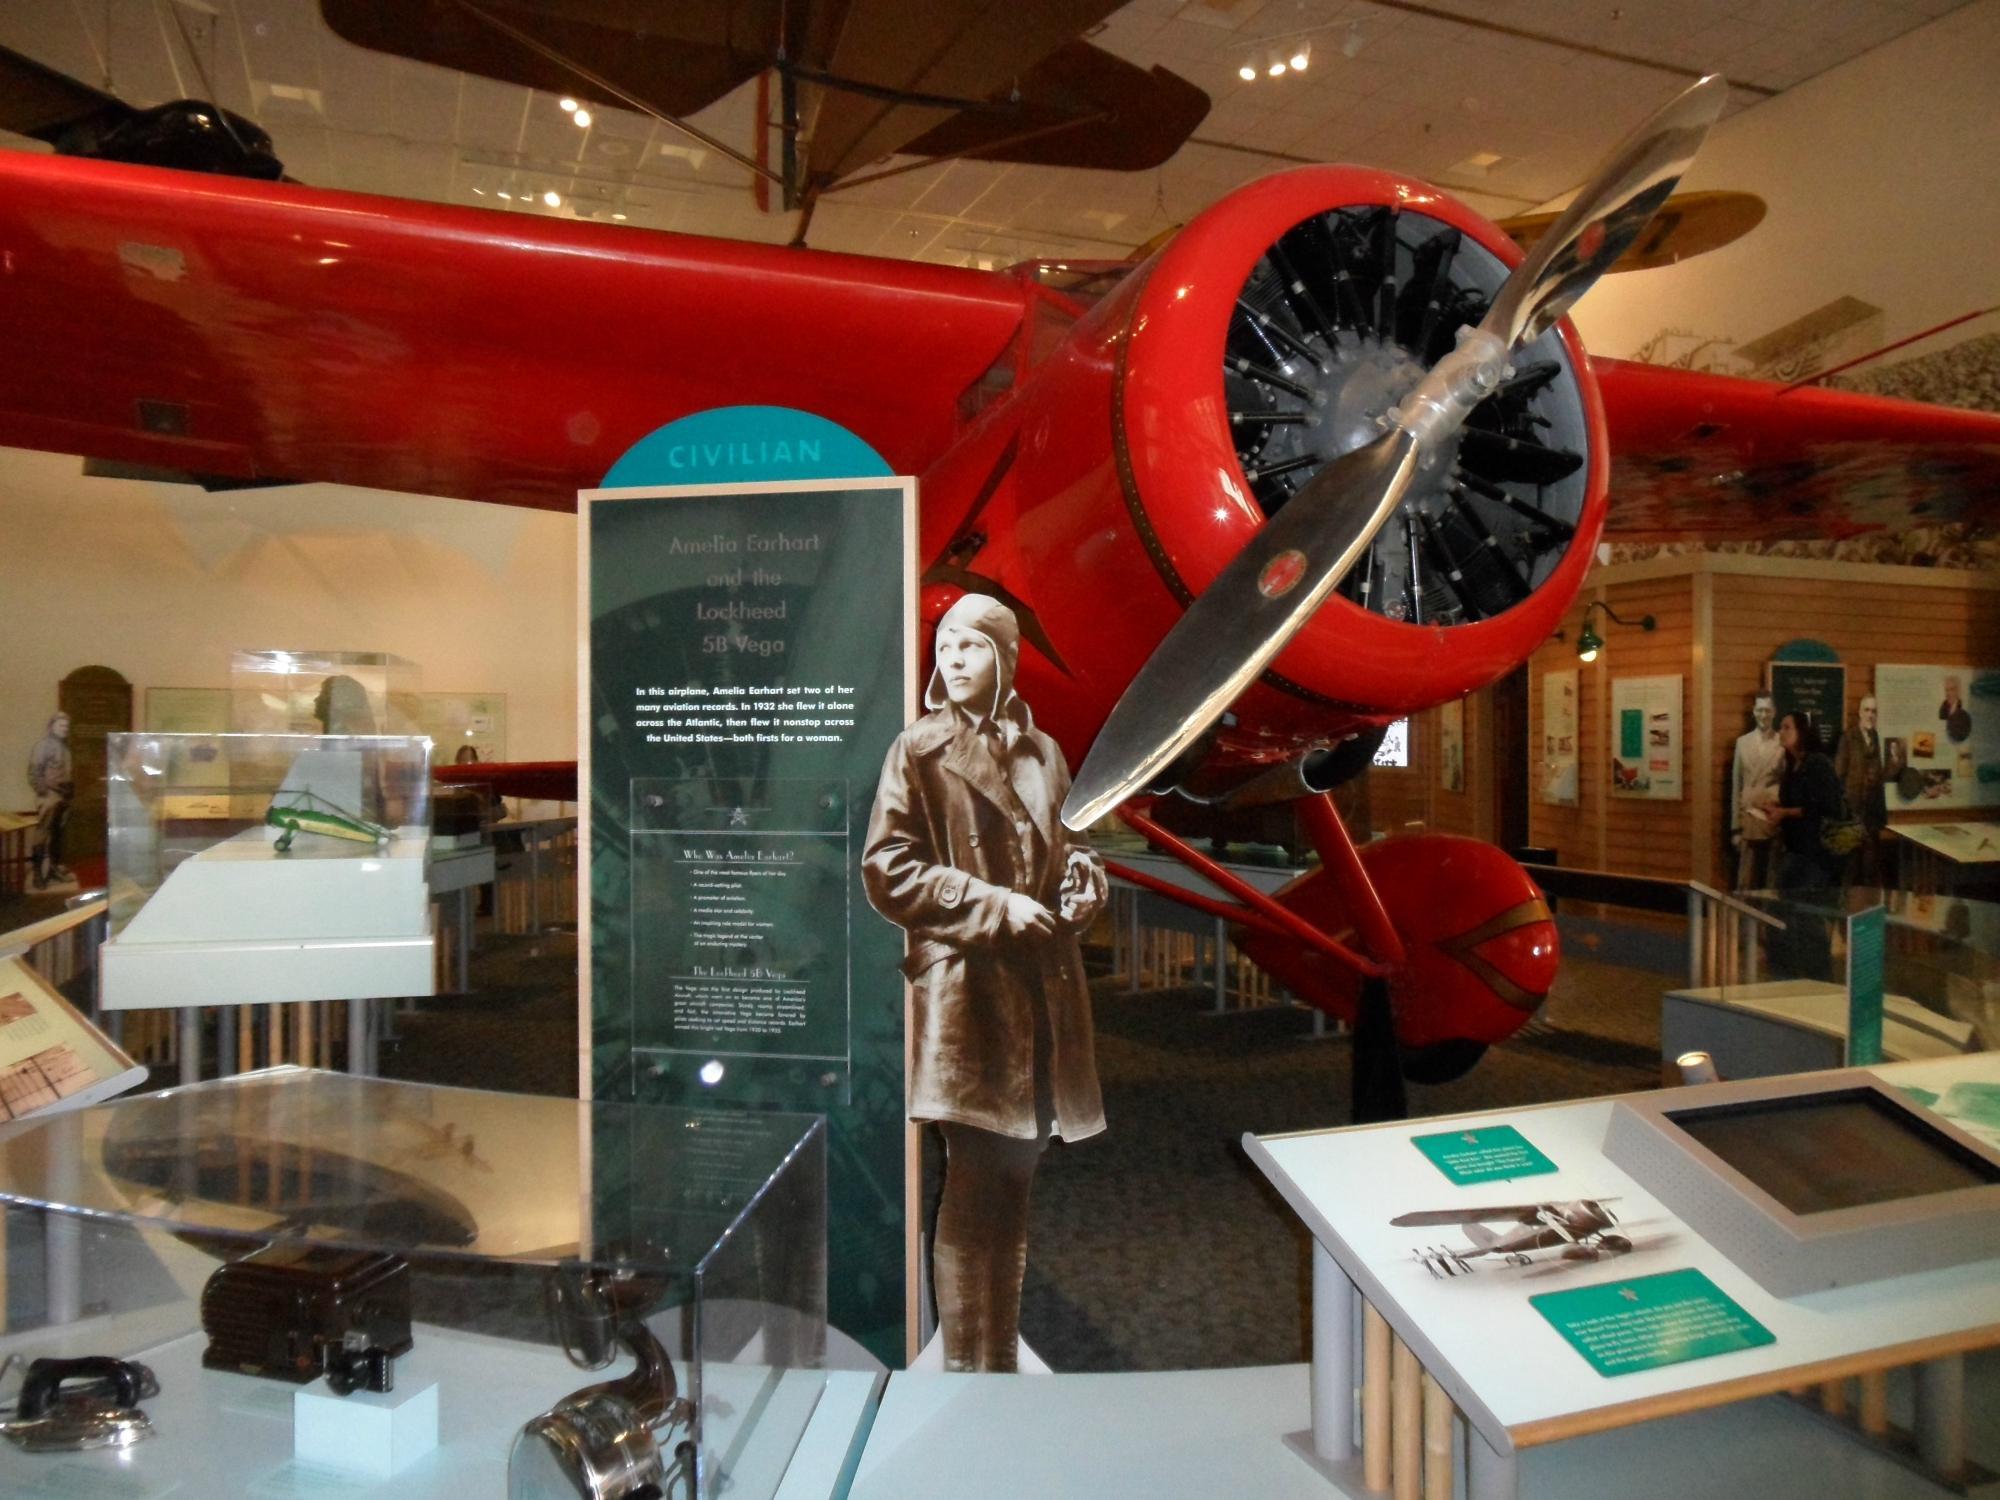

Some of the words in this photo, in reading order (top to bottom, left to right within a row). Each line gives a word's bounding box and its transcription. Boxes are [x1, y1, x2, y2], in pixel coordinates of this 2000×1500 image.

[668, 439, 822, 469] CIVILIAN
[669, 534, 738, 555] Amelia
[746, 533, 821, 552] Earhart
[706, 568, 742, 587] and
[752, 568, 782, 586] the
[696, 600, 787, 620] Lockheed
[702, 635, 728, 653] 5B
[735, 634, 785, 656] Vega
[636, 687, 646, 696] In
[648, 687, 665, 696] this
[668, 686, 710, 697] airplane,
[712, 686, 746, 695] Amelia
[748, 685, 784, 695] Earhart
[786, 686, 801, 695] set
[804, 686, 821, 695] two
[824, 685, 834, 694] of
[837, 685, 855, 694] her
[635, 704, 661, 713] many
[662, 702, 700, 711] aviation
[702, 702, 739, 711] records.
[741, 702, 751, 711] In
[753, 702, 776, 711] 1932
[777, 702, 794, 711] she
[796, 701, 816, 710] flew
[818, 701, 825, 710] it
[827, 701, 855, 710] alone
[635, 719, 665, 727] across
[667, 718, 682, 727] the
[685, 718, 723, 728] Atlantic,
[726, 718, 748, 727] then
[750, 717, 771, 727] flew
[773, 717, 780, 726] it
[783, 718, 821, 728] nonstop
[824, 718, 855, 726] across
[646, 734, 662, 743] the
[663, 733, 694, 743] United
[756, 733, 779, 742] firsts
[781, 733, 795, 742] for
